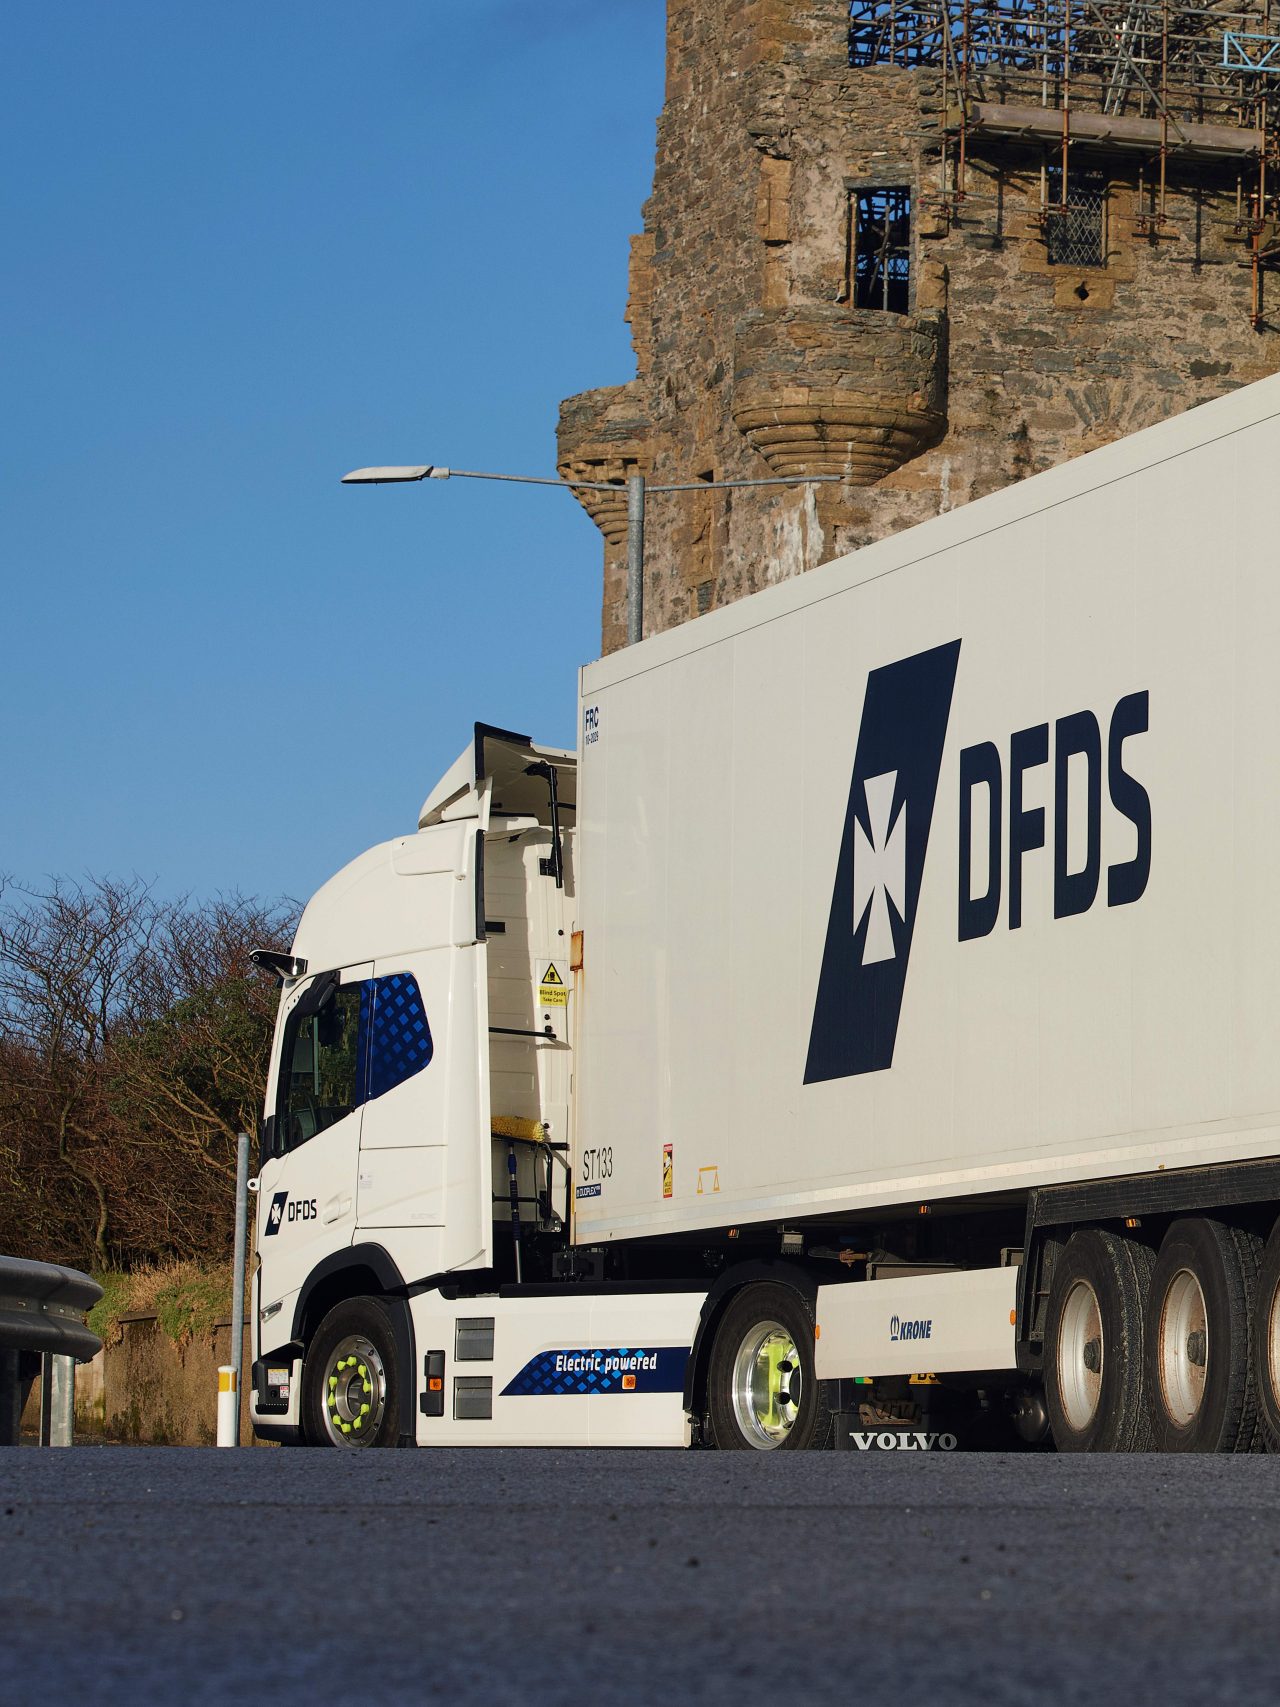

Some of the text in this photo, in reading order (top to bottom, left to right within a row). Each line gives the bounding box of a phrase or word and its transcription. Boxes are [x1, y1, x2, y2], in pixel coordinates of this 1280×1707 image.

[585, 706, 599, 731] FRC
[958, 690, 1151, 942] DFDS
[554, 990, 567, 998] Spot
[582, 1146, 613, 1181] ST133
[288, 1199, 317, 1222] DFDS
[900, 1320, 932, 1340] KRONE
[555, 1352, 657, 1374] Electric powered
[848, 1432, 958, 1450] VOLVO
